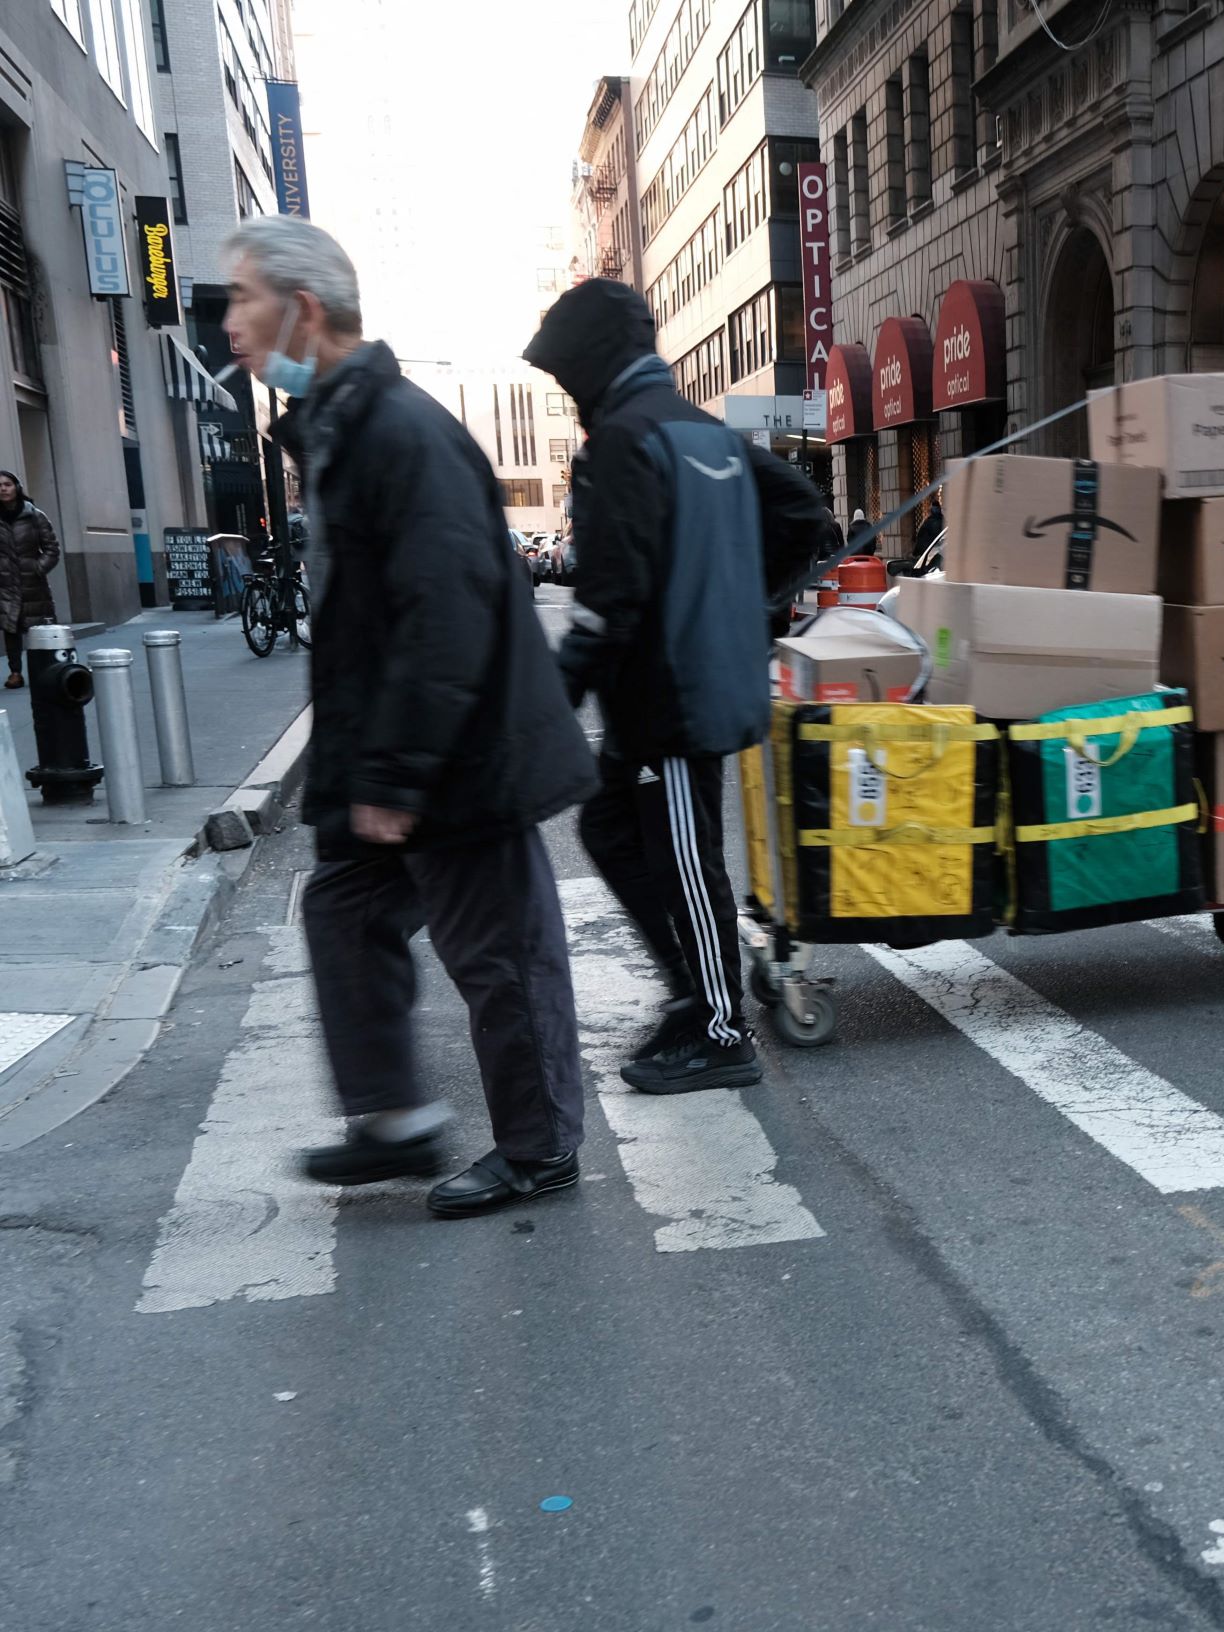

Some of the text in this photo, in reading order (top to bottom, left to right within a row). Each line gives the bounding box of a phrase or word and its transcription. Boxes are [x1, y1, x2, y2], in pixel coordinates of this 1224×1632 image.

[278, 112, 302, 218] NIVERSITY
[83, 180, 120, 292] OCULUS
[144, 223, 171, 299] Bareburger
[943, 323, 971, 373] pride
[879, 354, 902, 398] pride
[947, 370, 970, 400] optical
[828, 378, 845, 416] pride
[883, 395, 902, 421] optical
[763, 414, 793, 428] THE
[832, 414, 846, 435] optical
